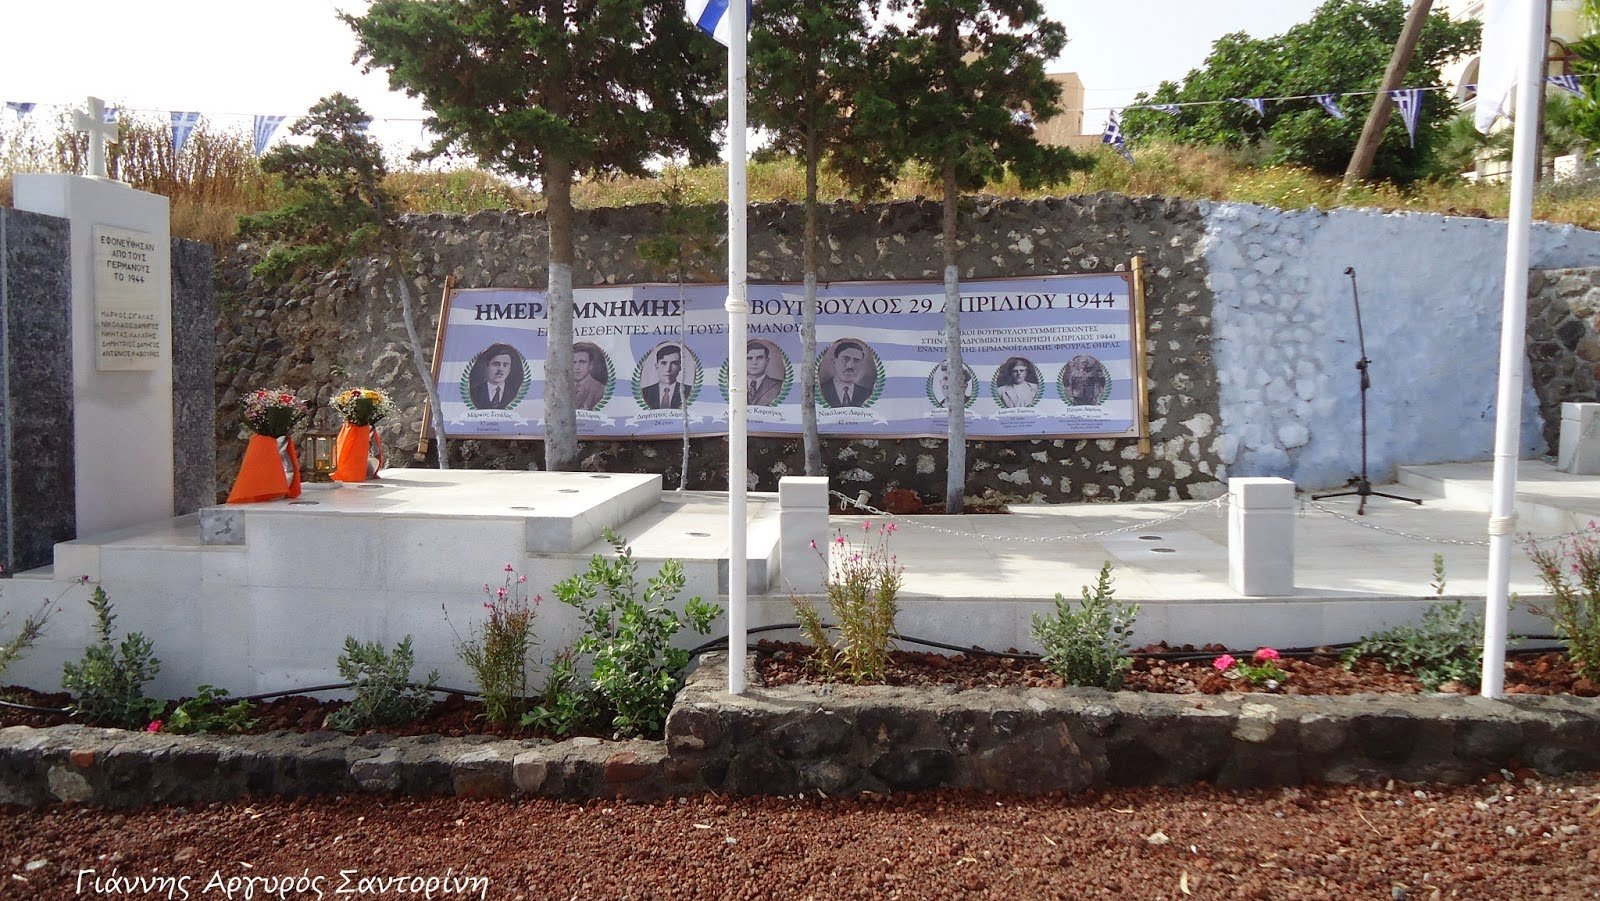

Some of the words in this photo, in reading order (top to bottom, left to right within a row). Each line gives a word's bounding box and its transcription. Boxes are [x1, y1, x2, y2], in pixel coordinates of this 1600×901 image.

[100, 235, 154, 251] ΕΦΟΝΕΥΘΗΣΑΝ
[112, 249, 127, 259] ΑΠΟ
[128, 251, 147, 262] ΤΟΥΣ
[106, 260, 150, 274] ΓΕΡΜΑΝΟΥΣ
[114, 272, 124, 281] ΤΟ
[128, 274, 145, 284] 1944
[909, 299, 932, 313] 29
[940, 294, 1056, 313] ΠΡΙΛΙΟΥ
[1067, 291, 1115, 309] 1944
[475, 302, 548, 320] ΗΜΕΡ
[573, 299, 685, 319] ΜΝΗΜΗΣ
[537, 324, 649, 337] ΕΛΕΣΘΕΝΤΕΣ
[688, 323, 724, 335] ΤΟΥΣ
[945, 337, 1001, 345] ΑΔΡΟΜΙΚΗ
